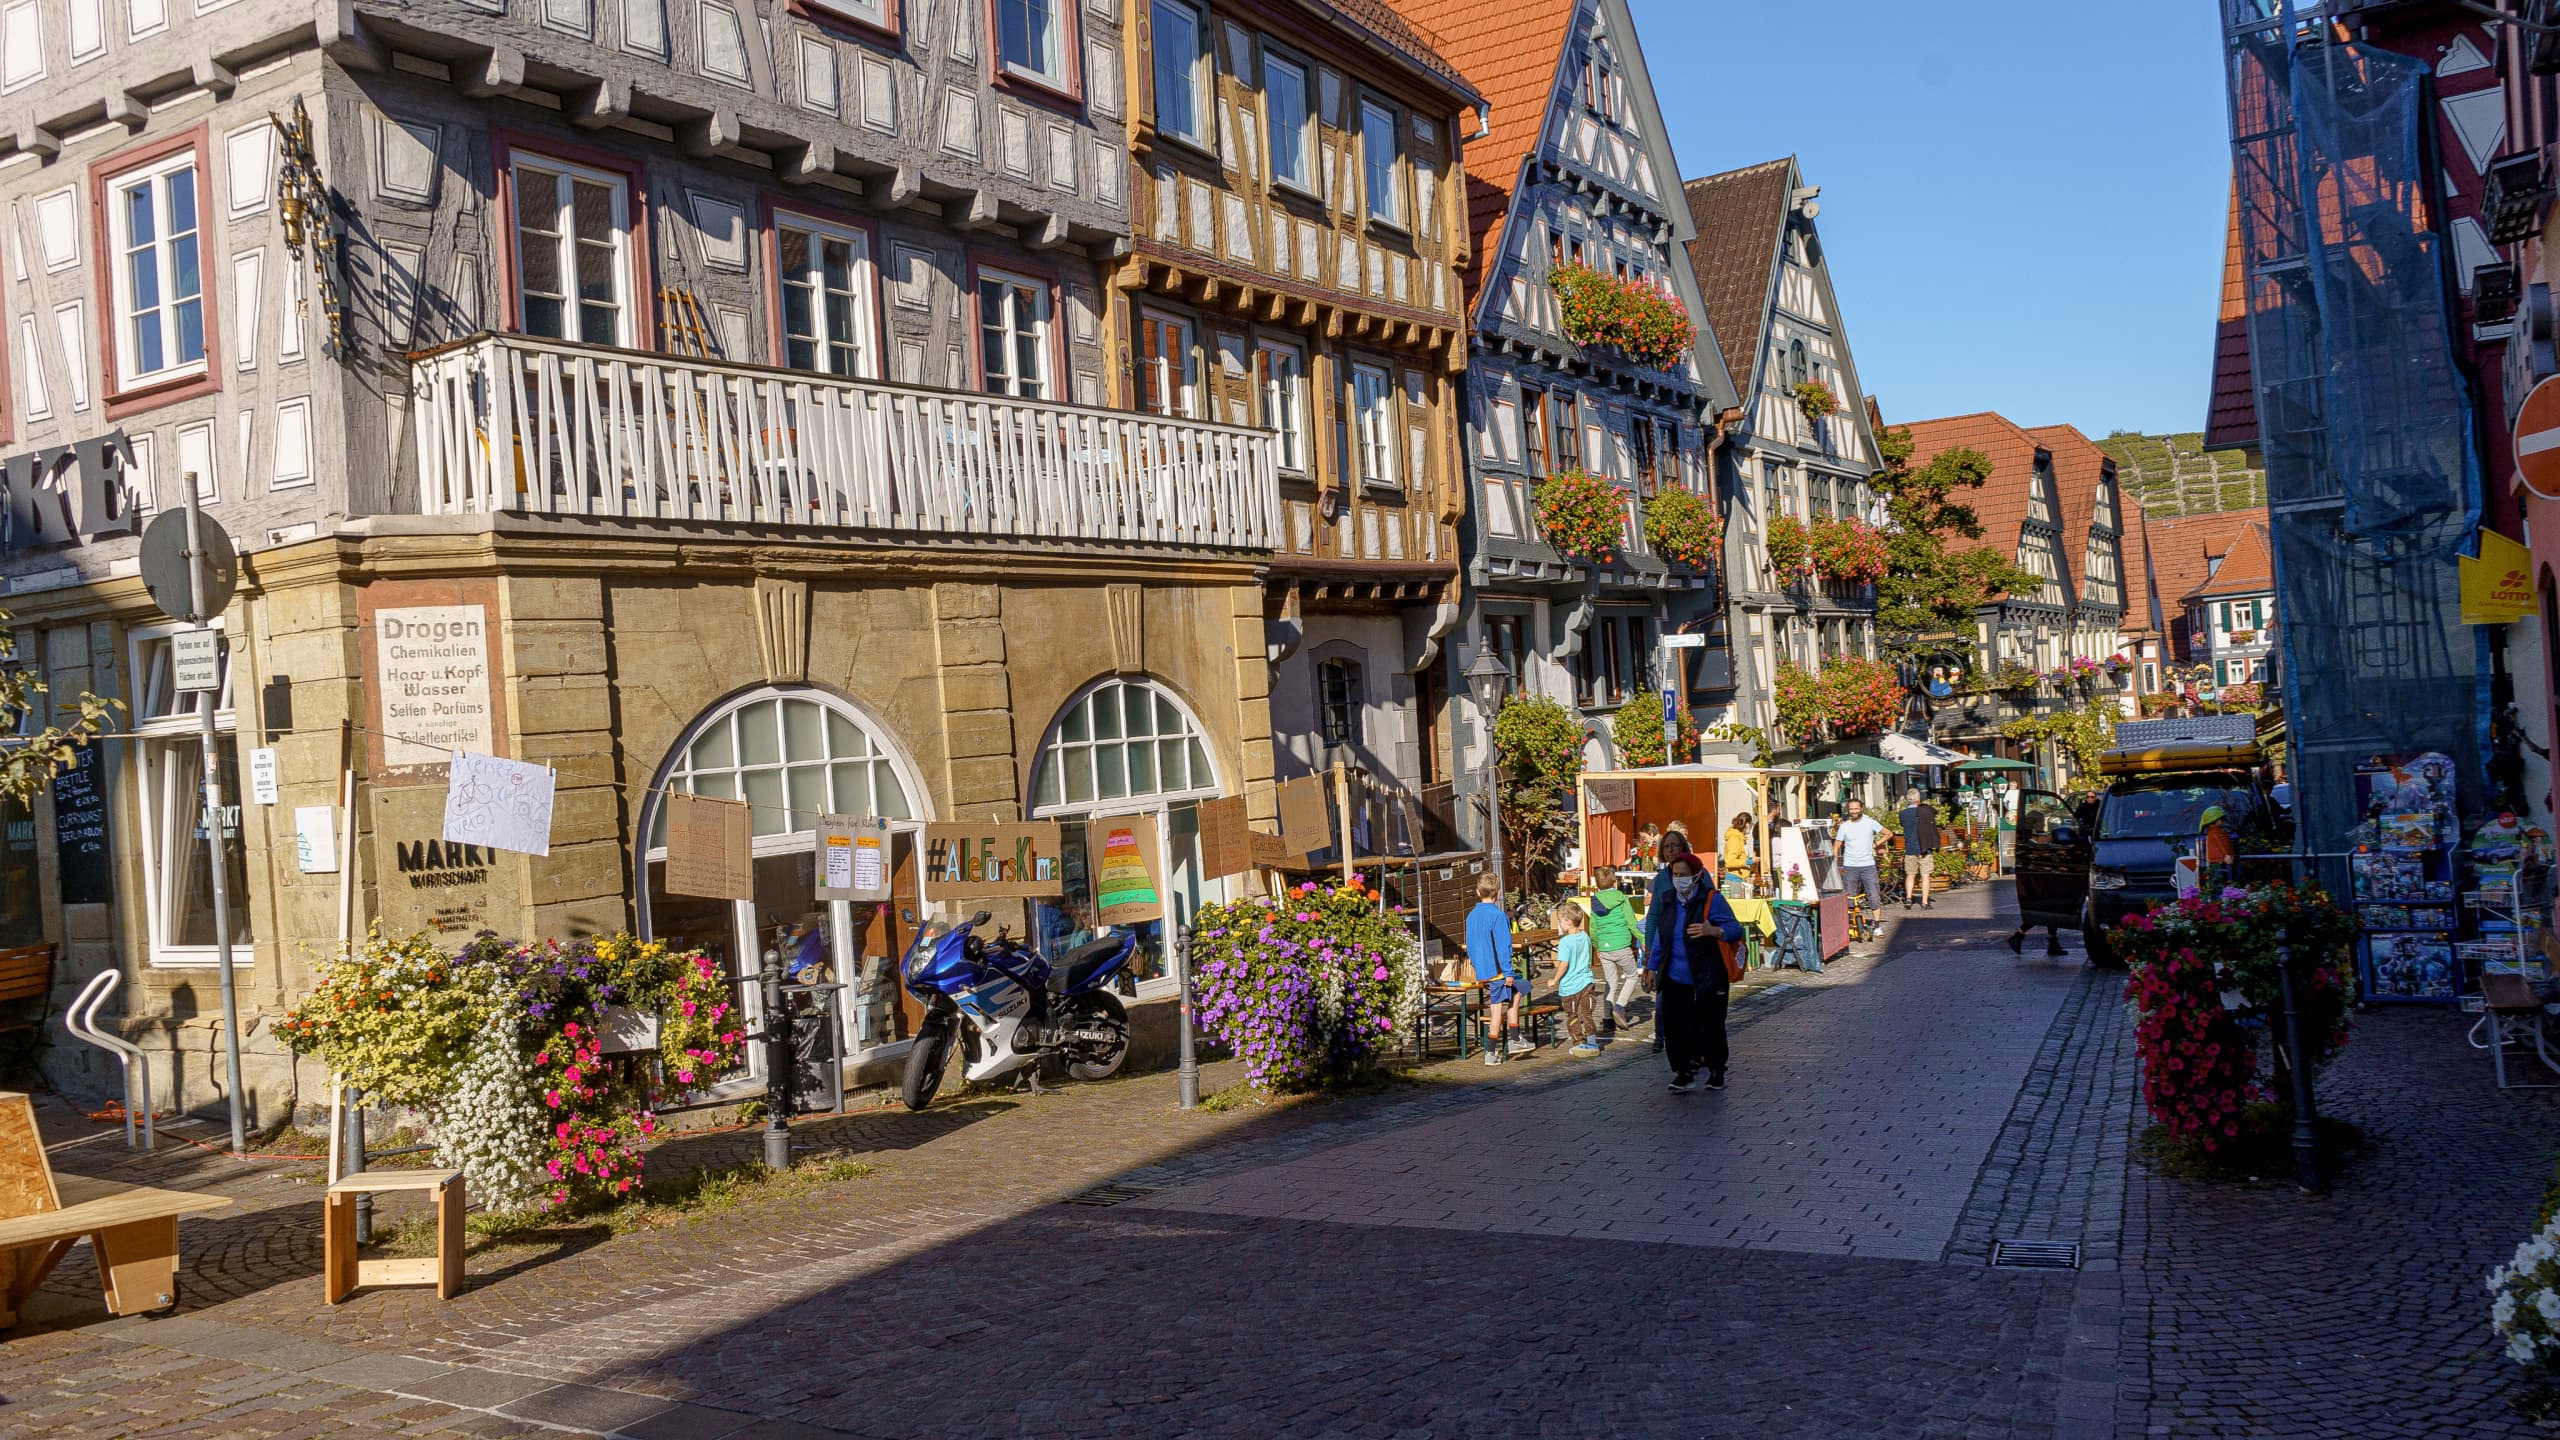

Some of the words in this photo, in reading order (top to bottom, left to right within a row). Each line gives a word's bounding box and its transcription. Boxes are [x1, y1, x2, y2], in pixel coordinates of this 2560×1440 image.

[2491, 591, 2530, 600] LOTTO
[384, 617, 480, 643] Drogen
[390, 643, 477, 659] Chemikalien
[404, 683, 466, 697] Wasser
[390, 703, 427, 718] Seifen
[432, 701, 484, 716] Parfüms
[398, 728, 478, 745] Toiletteartikel
[202, 805, 241, 829] MRKT
[927, 837, 1060, 882] #AlleFürsKlima
[409, 869, 488, 889] WIRTSCHAFT
[999, 996, 1028, 1019] SUZUKI
